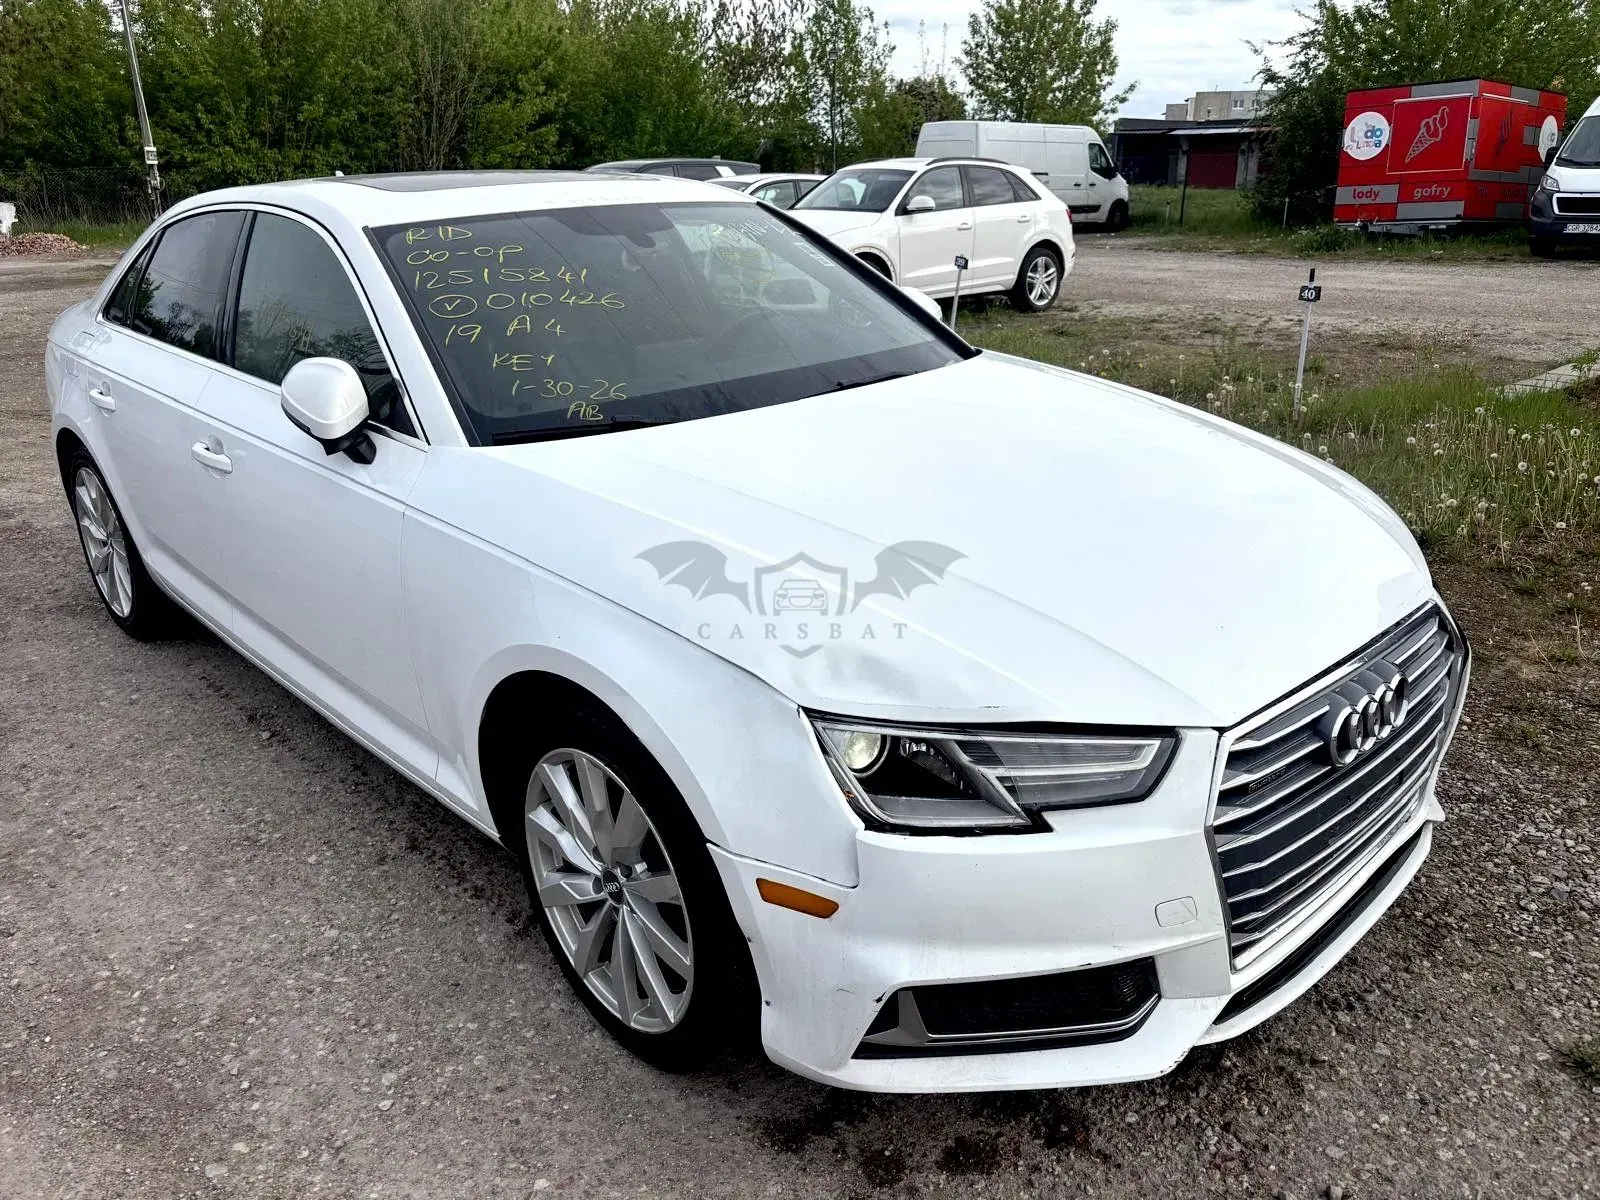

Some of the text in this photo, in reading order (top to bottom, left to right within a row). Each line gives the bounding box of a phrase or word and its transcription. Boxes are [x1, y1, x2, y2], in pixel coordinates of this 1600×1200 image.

[1352, 188, 1380, 200] lody
[1413, 184, 1450, 199] gofry
[1301, 289, 1315, 299] 40
[445, 324, 482, 346] 19
[492, 353, 555, 371] KEY
[511, 379, 628, 401] 1-30-26
[567, 400, 603, 420] AB
